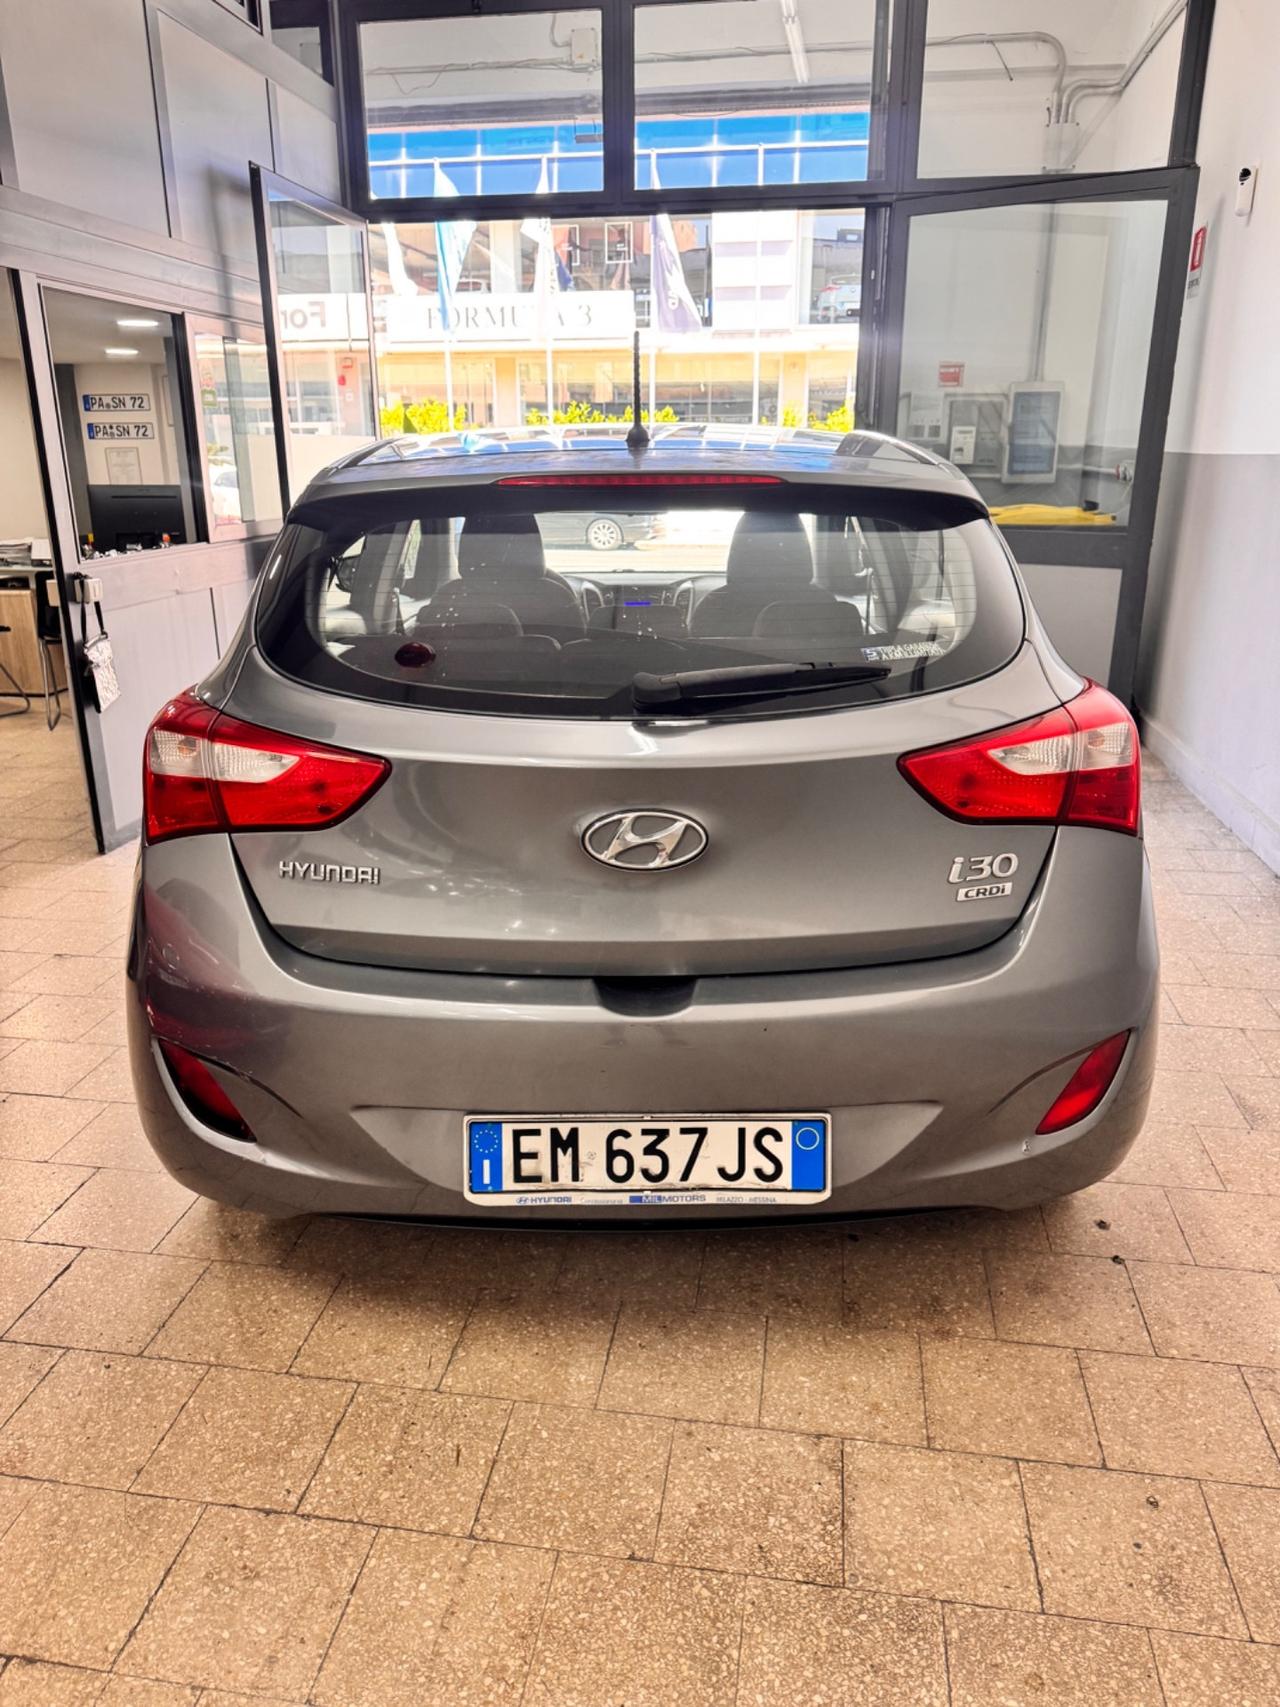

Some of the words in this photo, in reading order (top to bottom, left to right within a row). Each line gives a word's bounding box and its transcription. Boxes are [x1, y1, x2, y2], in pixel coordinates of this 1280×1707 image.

[91, 396, 104, 409] PA
[111, 396, 126, 409] SN
[130, 396, 144, 409] 72
[95, 425, 108, 437] PA
[116, 425, 130, 437] SN
[134, 425, 149, 437] 72
[279, 861, 379, 884] HYUNDAI
[948, 852, 1018, 883] i30
[964, 884, 1006, 899] CRDi
[512, 1127, 580, 1183] EM
[605, 1127, 708, 1183] 637
[717, 1127, 783, 1183] JS
[530, 1196, 572, 1204] HYUNDAI
